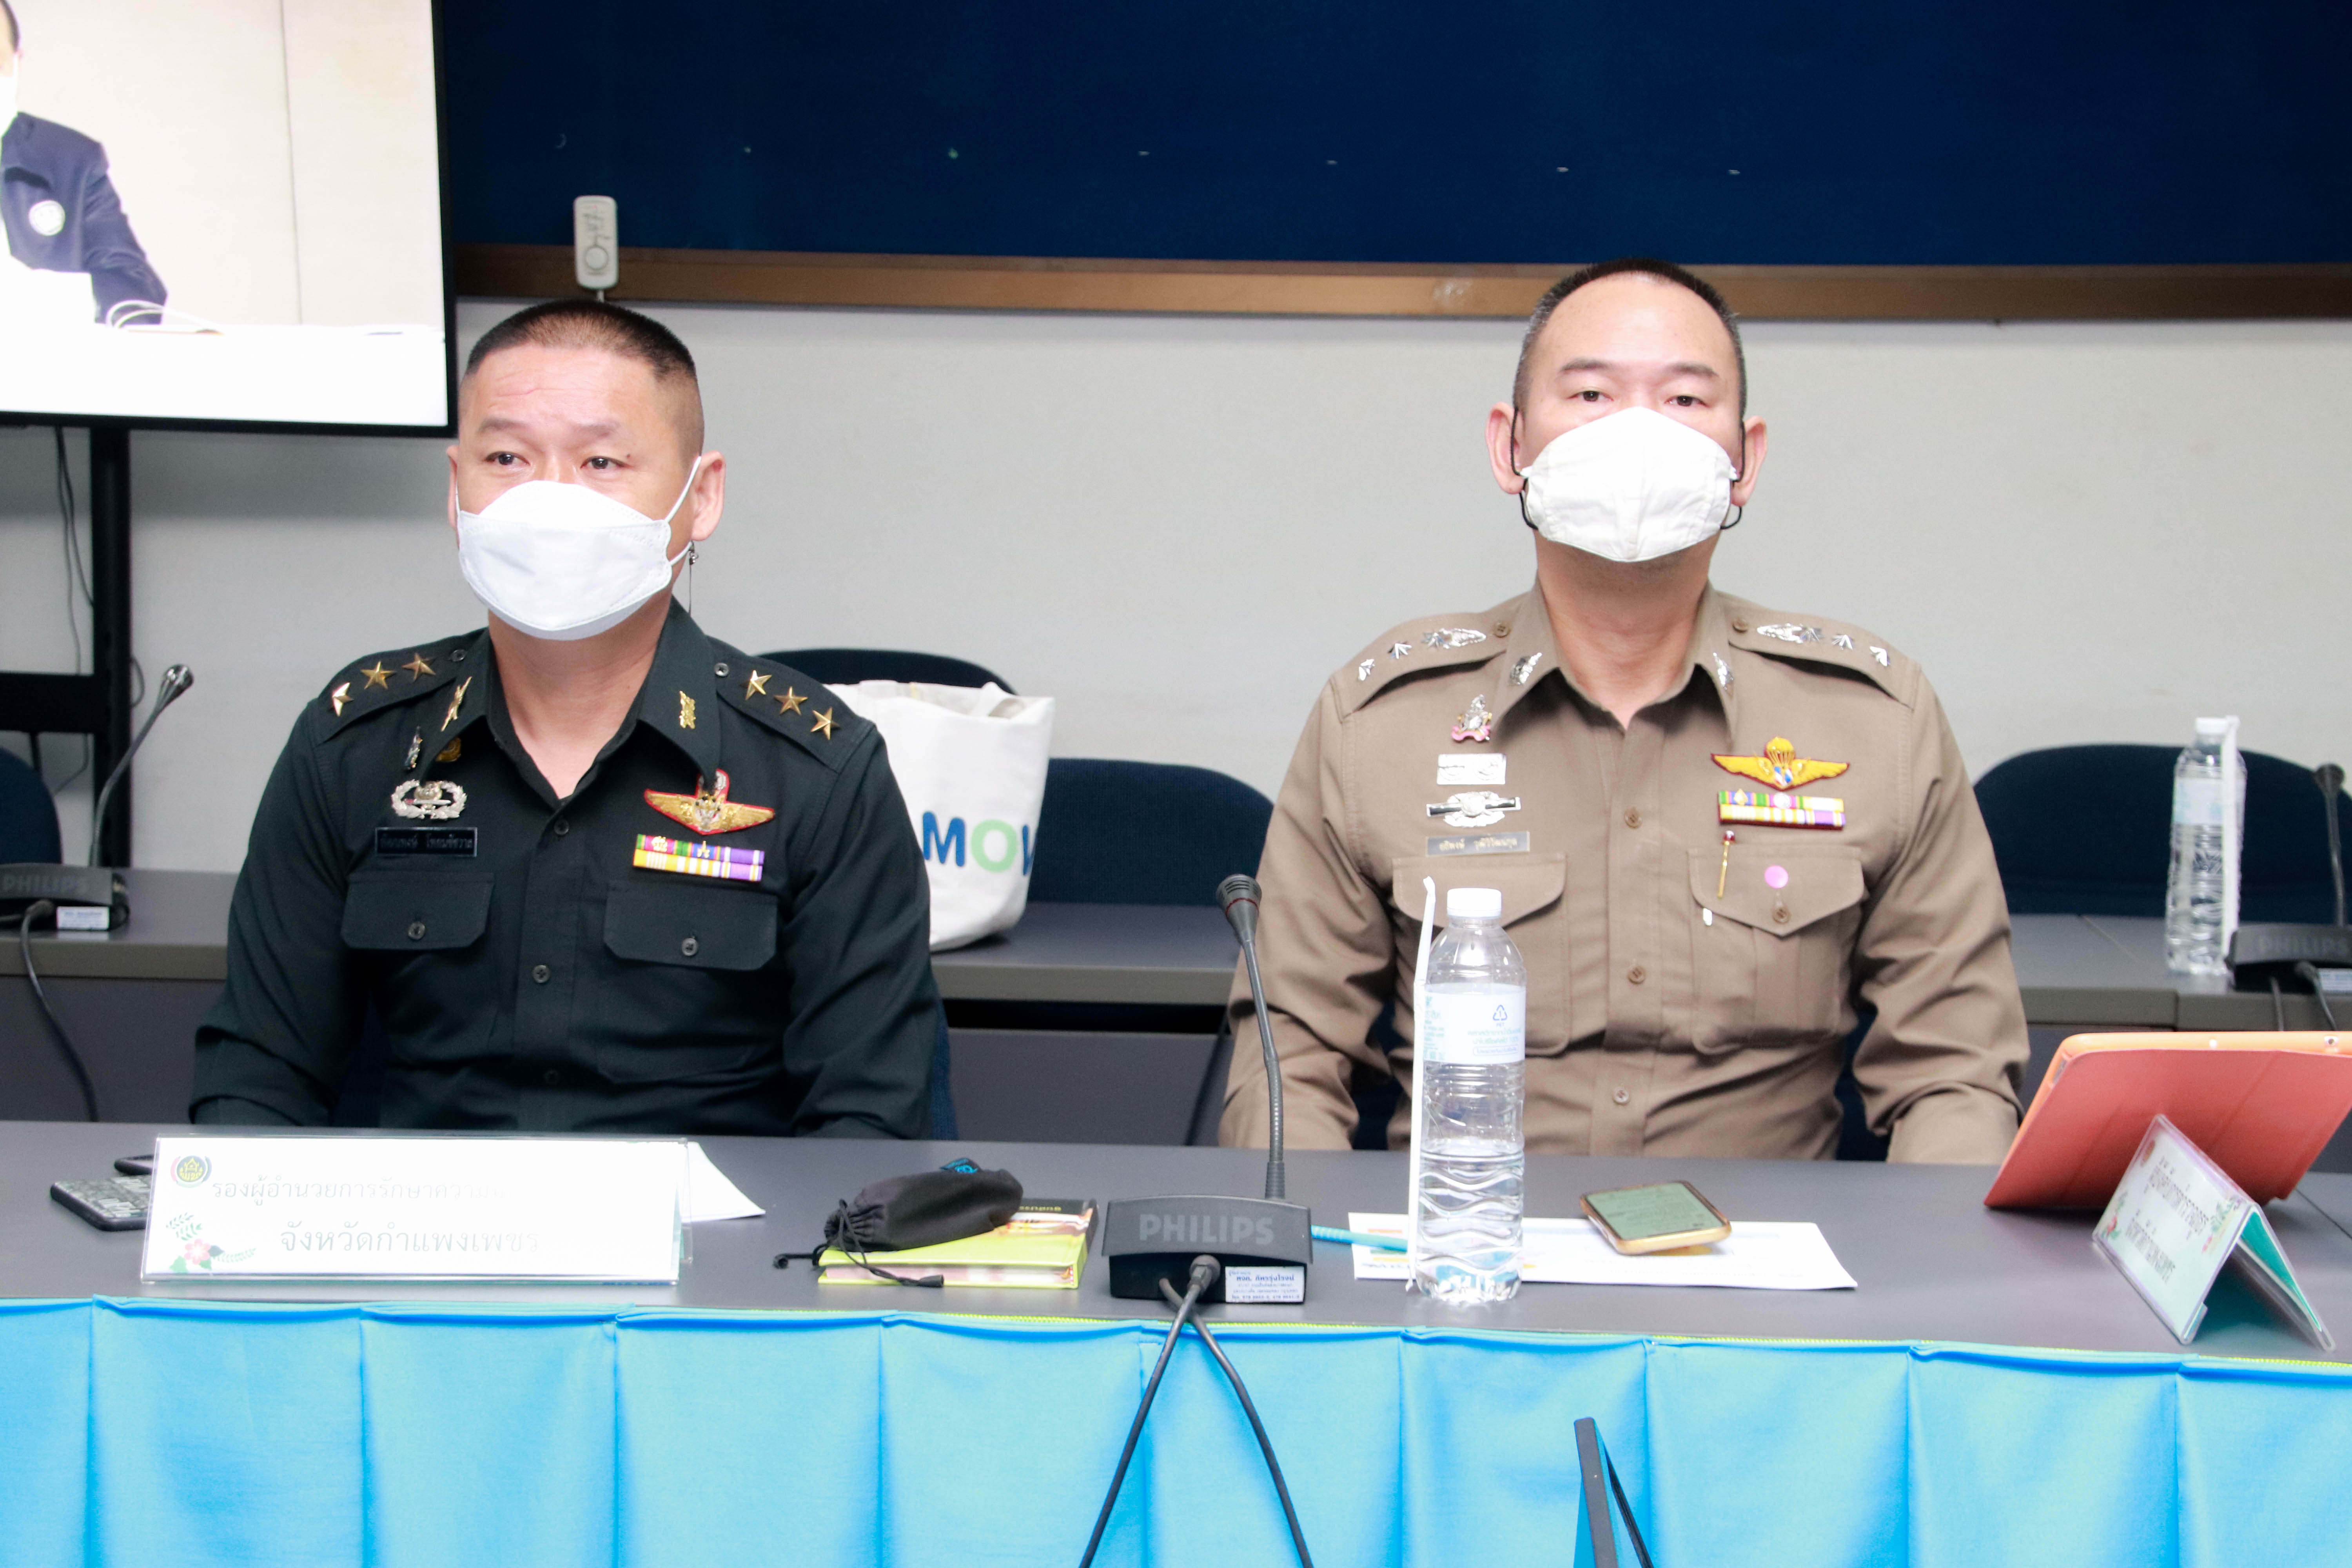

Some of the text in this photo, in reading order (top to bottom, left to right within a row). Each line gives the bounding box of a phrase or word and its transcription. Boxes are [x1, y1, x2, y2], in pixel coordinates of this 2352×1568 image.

[279, 1220, 540, 1252] จังหวัดกำแพงเพชร
[1139, 1213, 1274, 1245] PHILIPS
